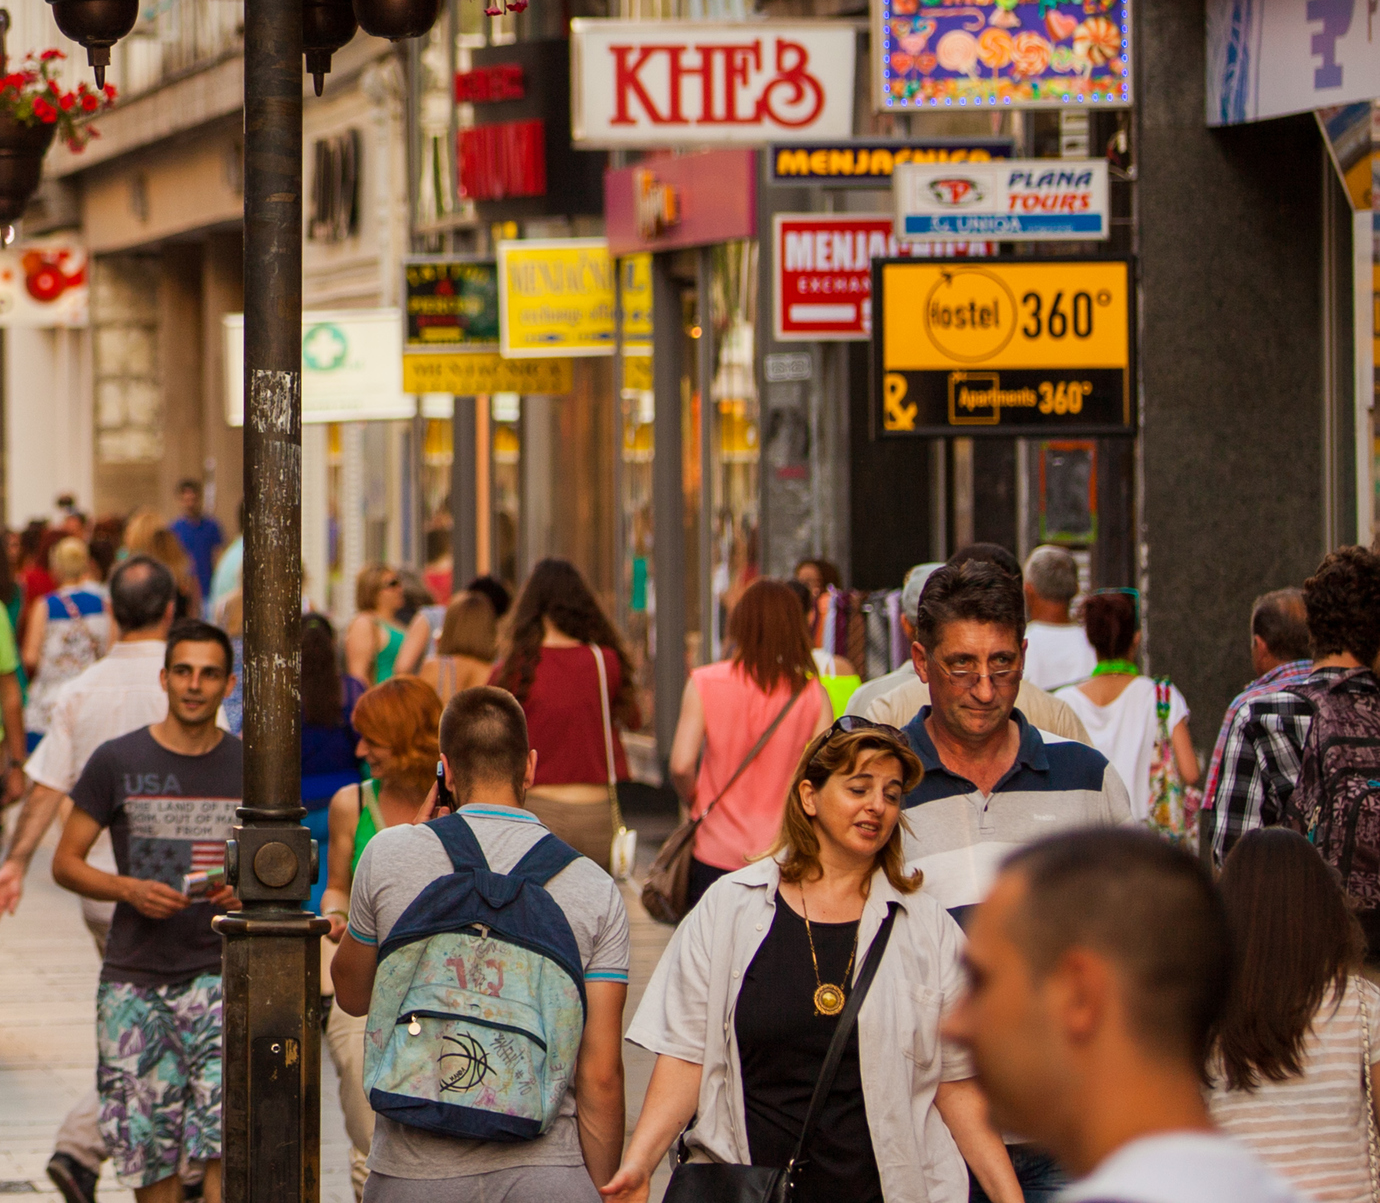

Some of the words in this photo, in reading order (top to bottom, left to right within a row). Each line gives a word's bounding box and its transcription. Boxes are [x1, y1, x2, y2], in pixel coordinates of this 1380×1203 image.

[1007, 169, 1094, 189] PLANA
[1008, 191, 1092, 213] TOURS
[797, 276, 872, 294] EXCHAN
[124, 773, 181, 795] USA
[157, 801, 196, 813] LAND
[202, 801, 217, 813] OF
[163, 814, 190, 825] OUT
[195, 814, 211, 825] OF
